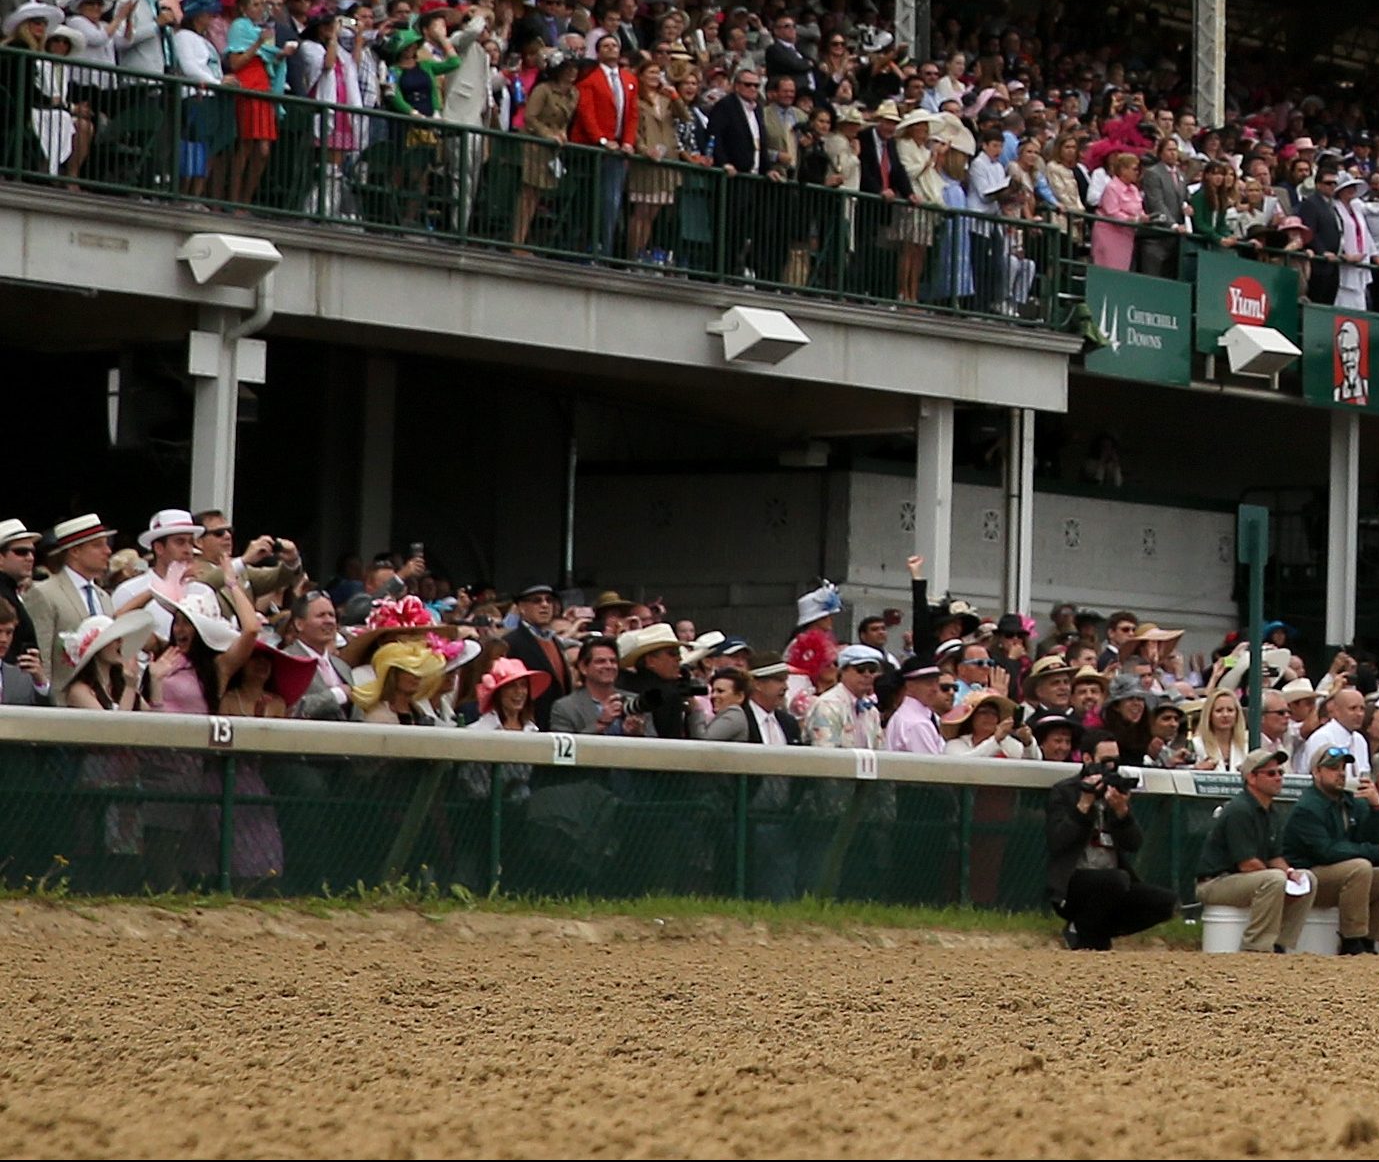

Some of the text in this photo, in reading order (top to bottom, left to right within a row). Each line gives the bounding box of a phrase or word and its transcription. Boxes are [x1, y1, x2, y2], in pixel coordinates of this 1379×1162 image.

[1228, 286, 1266, 320] Yum!
[1127, 304, 1178, 330] CHURCHILL
[1127, 327, 1162, 349] DOWNS
[210, 716, 232, 743] 13
[555, 736, 573, 758] 12
